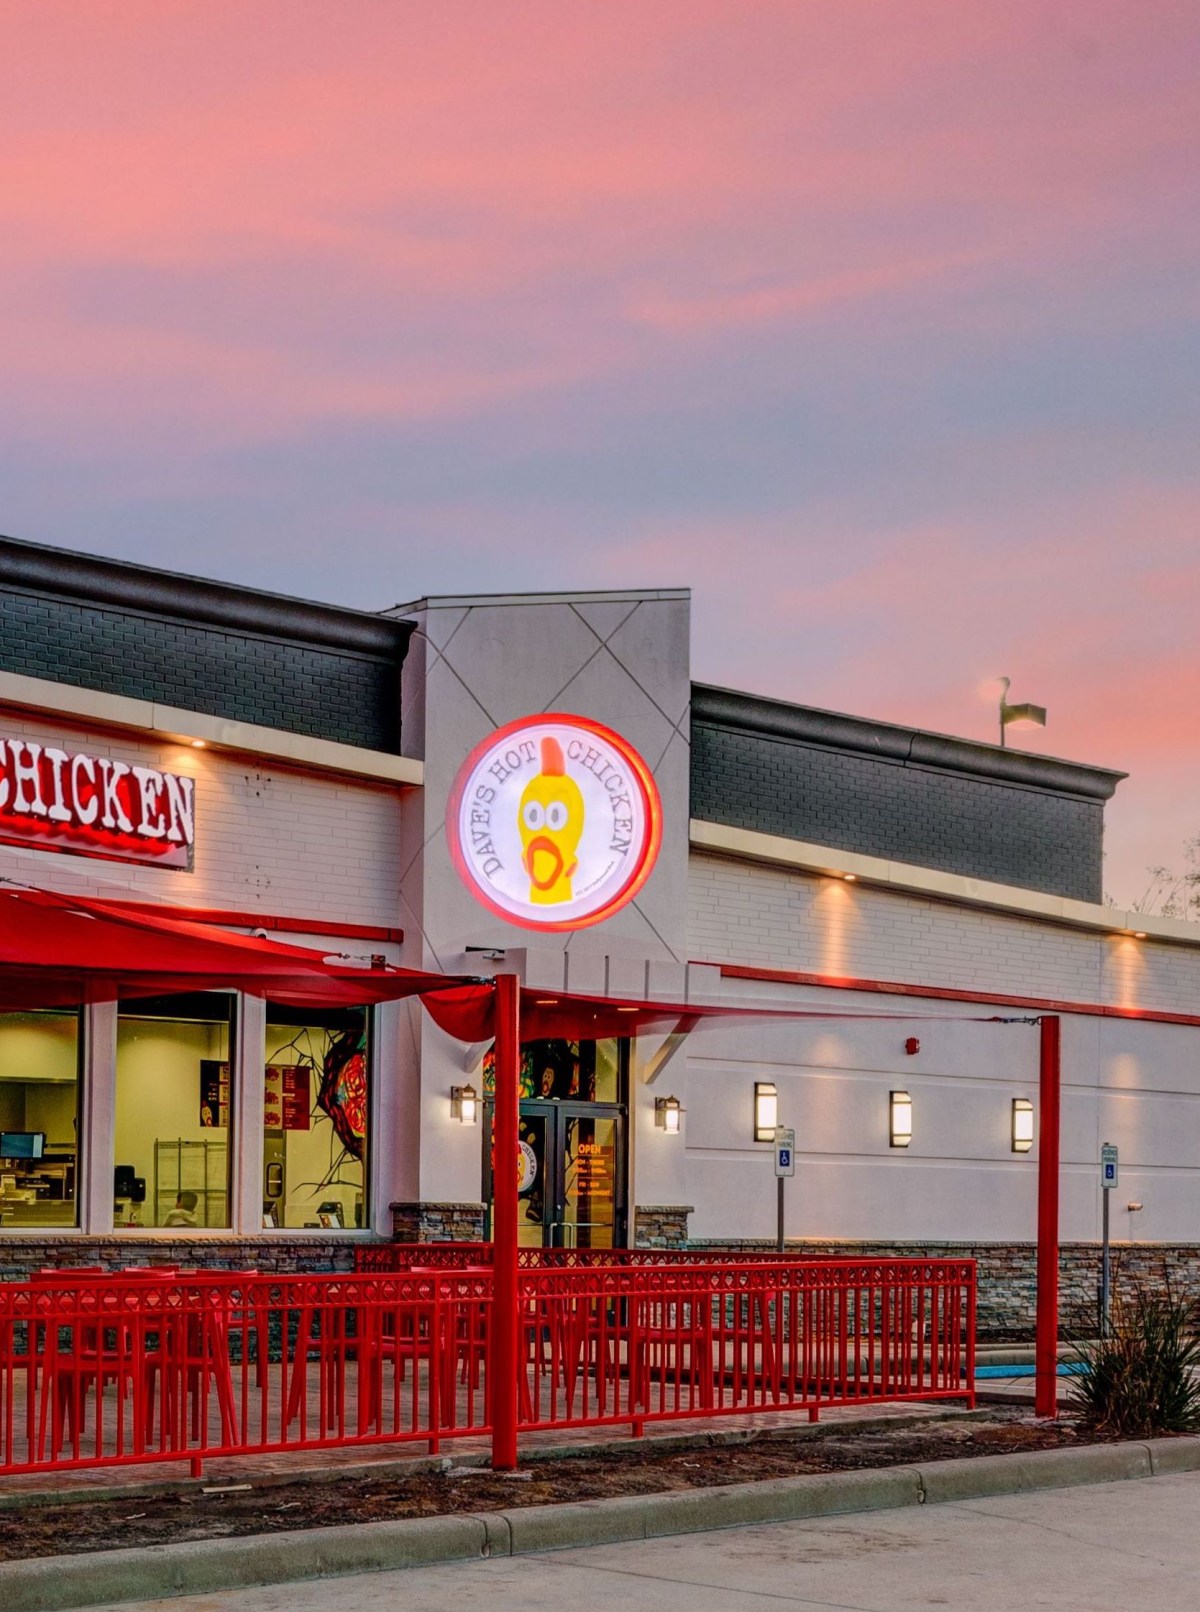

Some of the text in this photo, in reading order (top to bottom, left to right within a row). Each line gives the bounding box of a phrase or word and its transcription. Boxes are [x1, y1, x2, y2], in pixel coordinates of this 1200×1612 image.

[471, 739, 633, 879] DAVE'S HOT CHICKEN
[579, 1144, 601, 1154] OPEN
